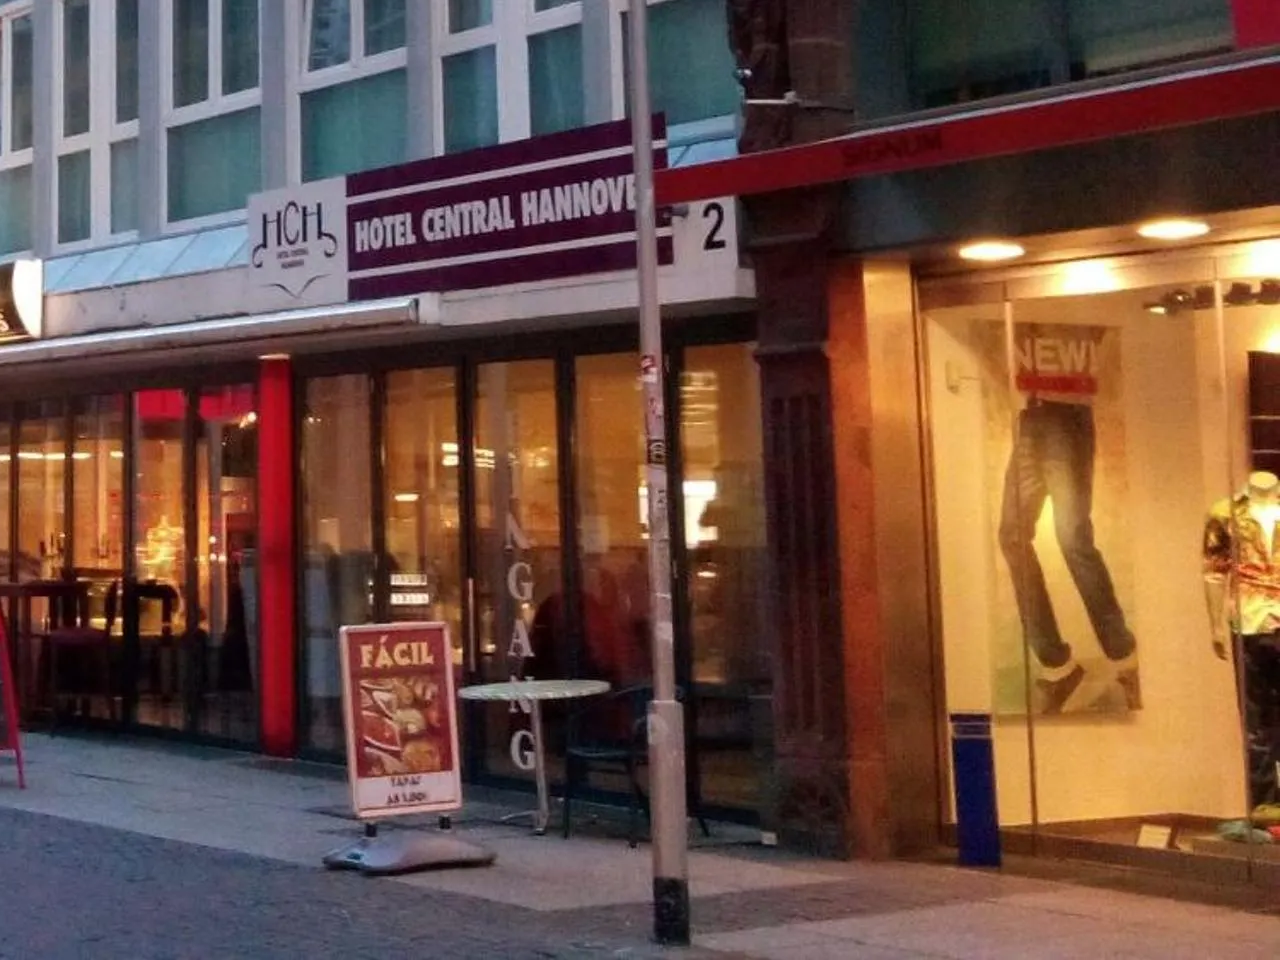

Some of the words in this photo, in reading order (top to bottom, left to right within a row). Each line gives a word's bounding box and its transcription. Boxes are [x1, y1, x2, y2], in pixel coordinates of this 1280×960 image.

[354, 212, 417, 253] HOTEL
[421, 195, 515, 242] CENTRAL
[521, 173, 640, 227] HANNOVE
[702, 201, 726, 251] 2
[359, 635, 435, 669] FÁCIL
